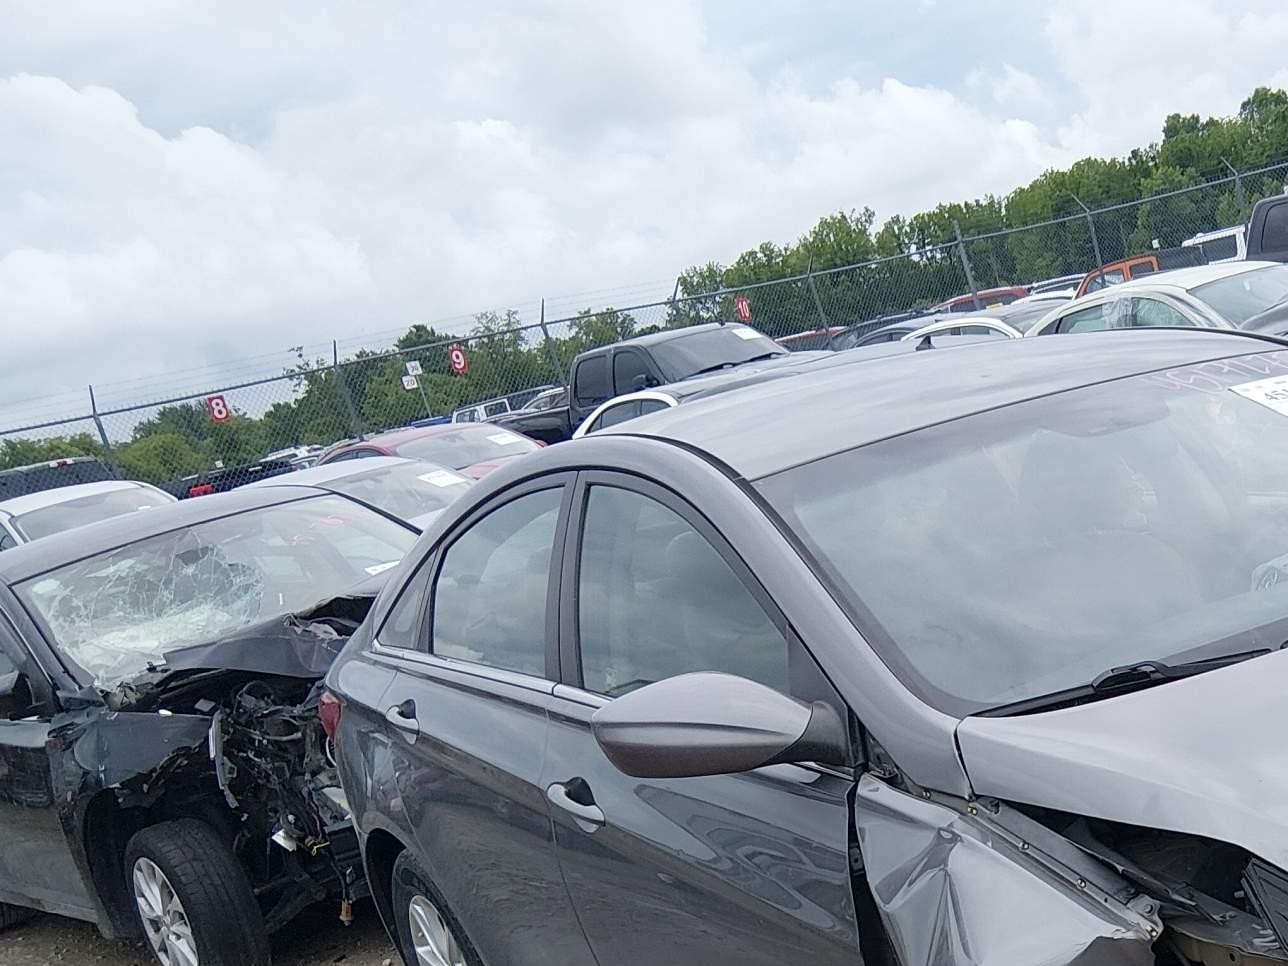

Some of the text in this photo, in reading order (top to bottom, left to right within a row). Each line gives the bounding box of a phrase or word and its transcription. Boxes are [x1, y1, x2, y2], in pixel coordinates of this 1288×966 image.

[738, 300, 750, 317] 10
[451, 350, 465, 369] 9
[211, 398, 227, 419] 8
